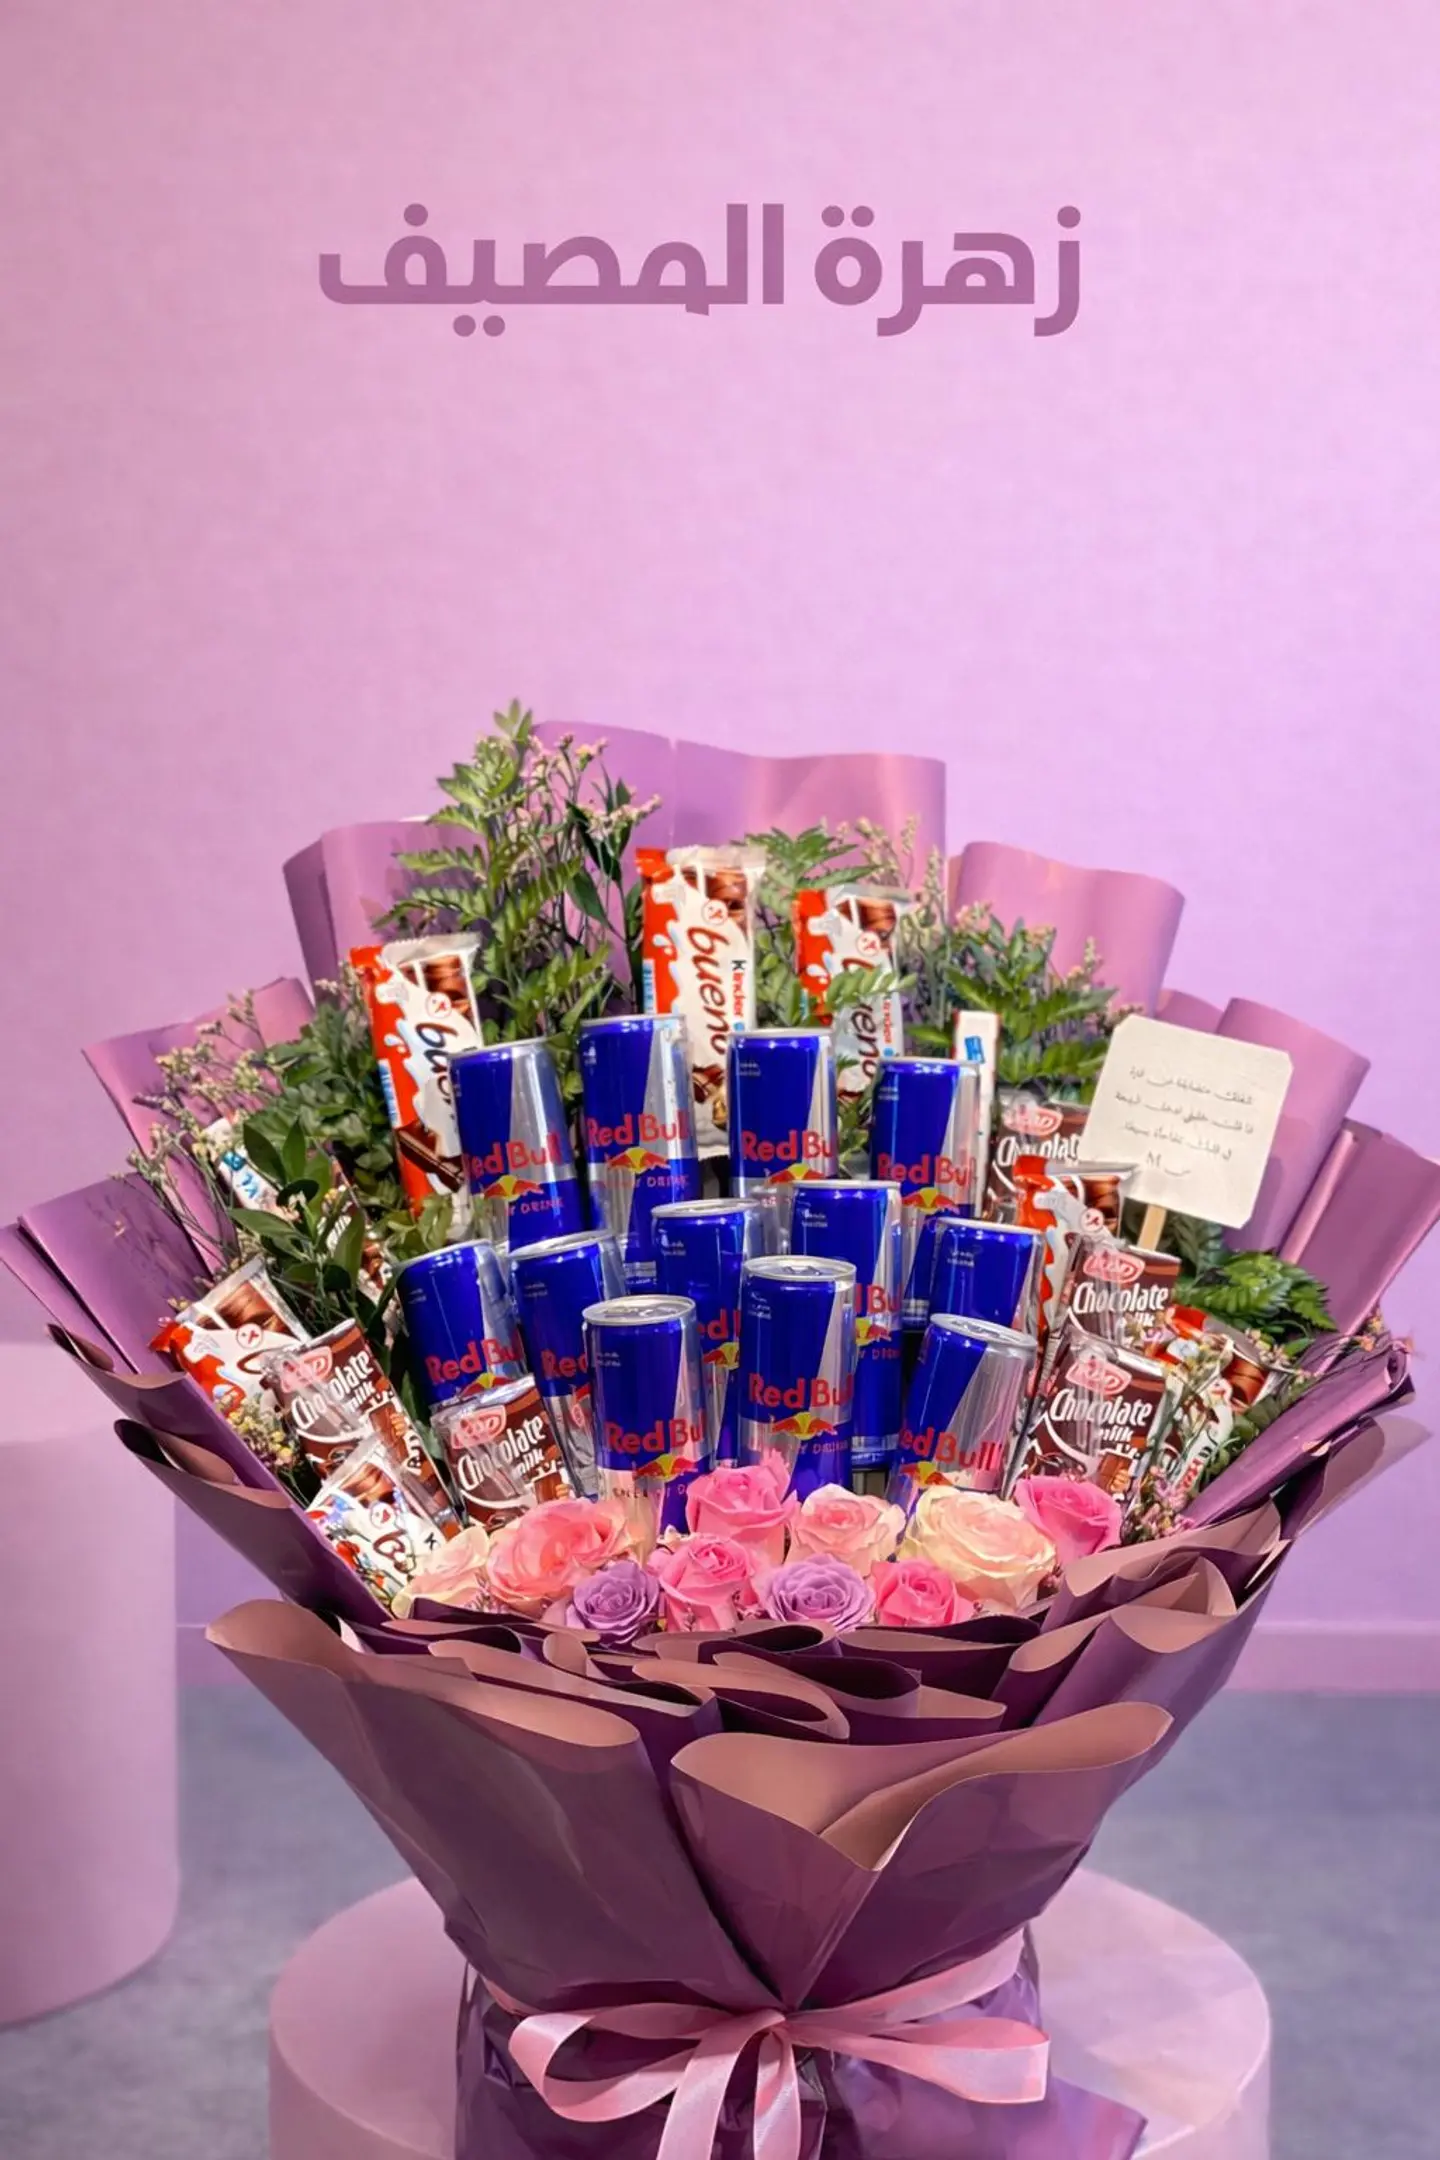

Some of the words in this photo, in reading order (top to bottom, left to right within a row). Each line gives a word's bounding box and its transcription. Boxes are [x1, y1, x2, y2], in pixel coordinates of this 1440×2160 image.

[686, 926, 731, 1056] bueno
[585, 1112, 634, 1148] Red
[741, 1129, 798, 1162] Red
[877, 1151, 931, 1184] Red
[1073, 1282, 1170, 1314] Chocolate
[425, 1340, 483, 1385] Red
[748, 1372, 806, 1410] Red
[1050, 1388, 1154, 1427] Chocolate
[603, 1420, 665, 1455] Red
